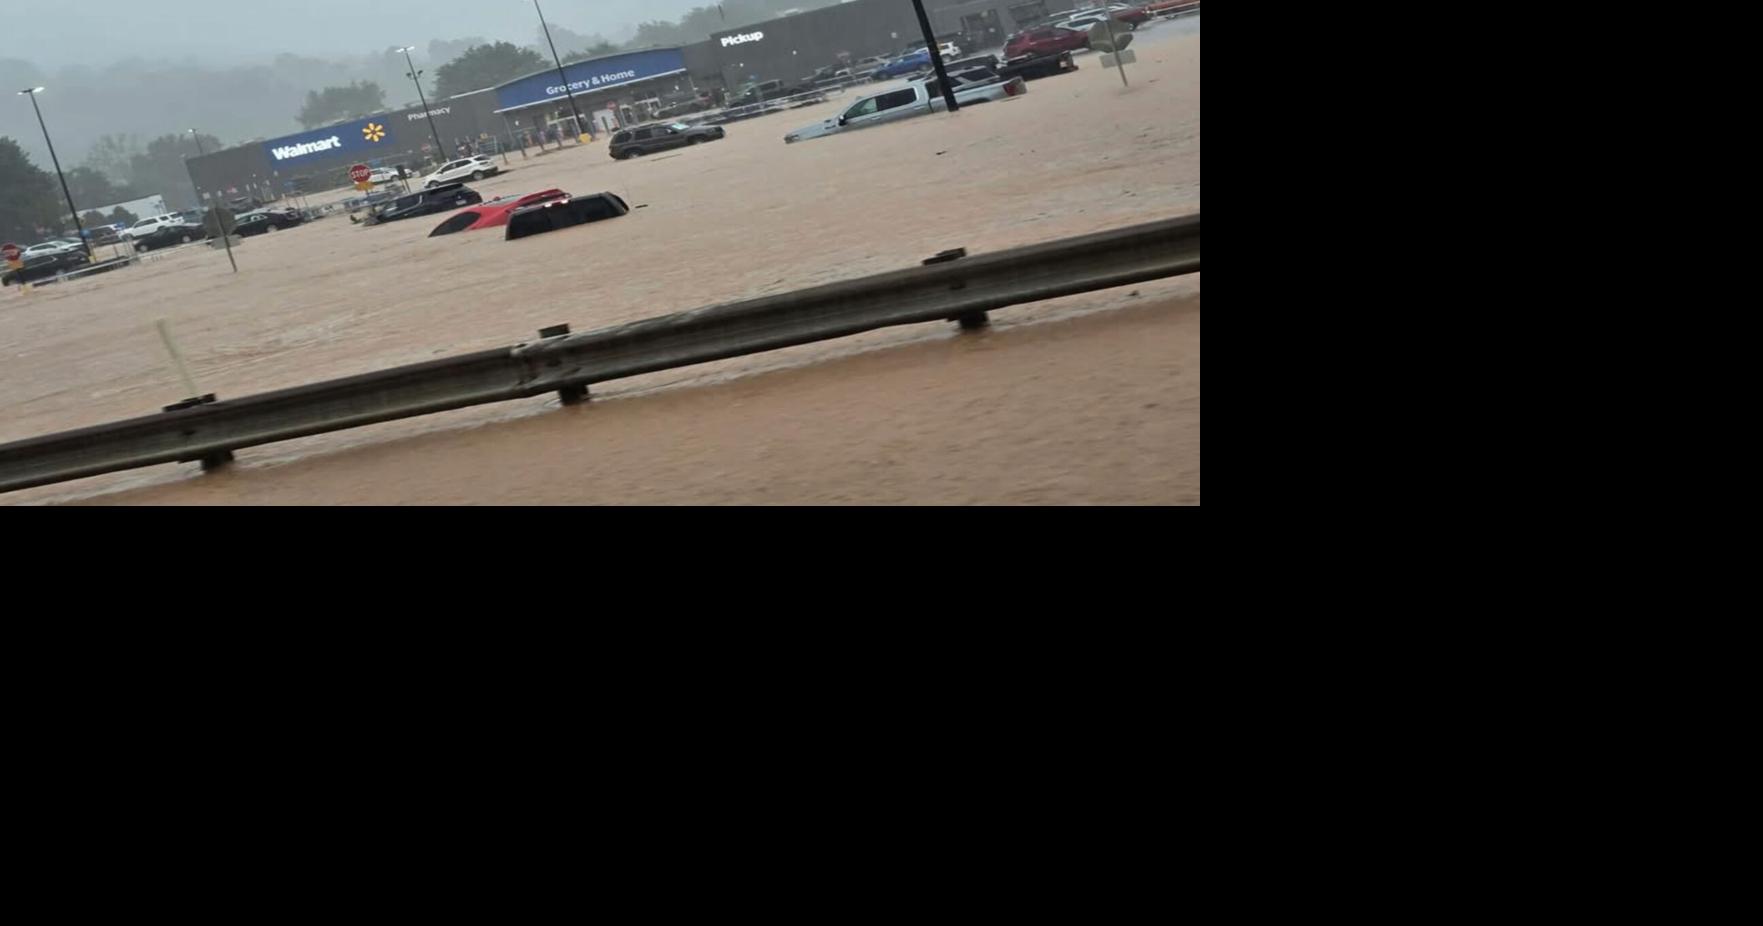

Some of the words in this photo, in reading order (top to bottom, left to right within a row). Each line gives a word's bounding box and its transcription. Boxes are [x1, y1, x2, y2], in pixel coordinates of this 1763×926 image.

[720, 31, 764, 47] Pickup
[546, 79, 590, 95] Grocery
[592, 76, 601, 85] &
[601, 70, 635, 83] Home
[408, 107, 450, 120] Pharmacy
[272, 136, 342, 160] Walmart
[351, 169, 369, 179] STOP
